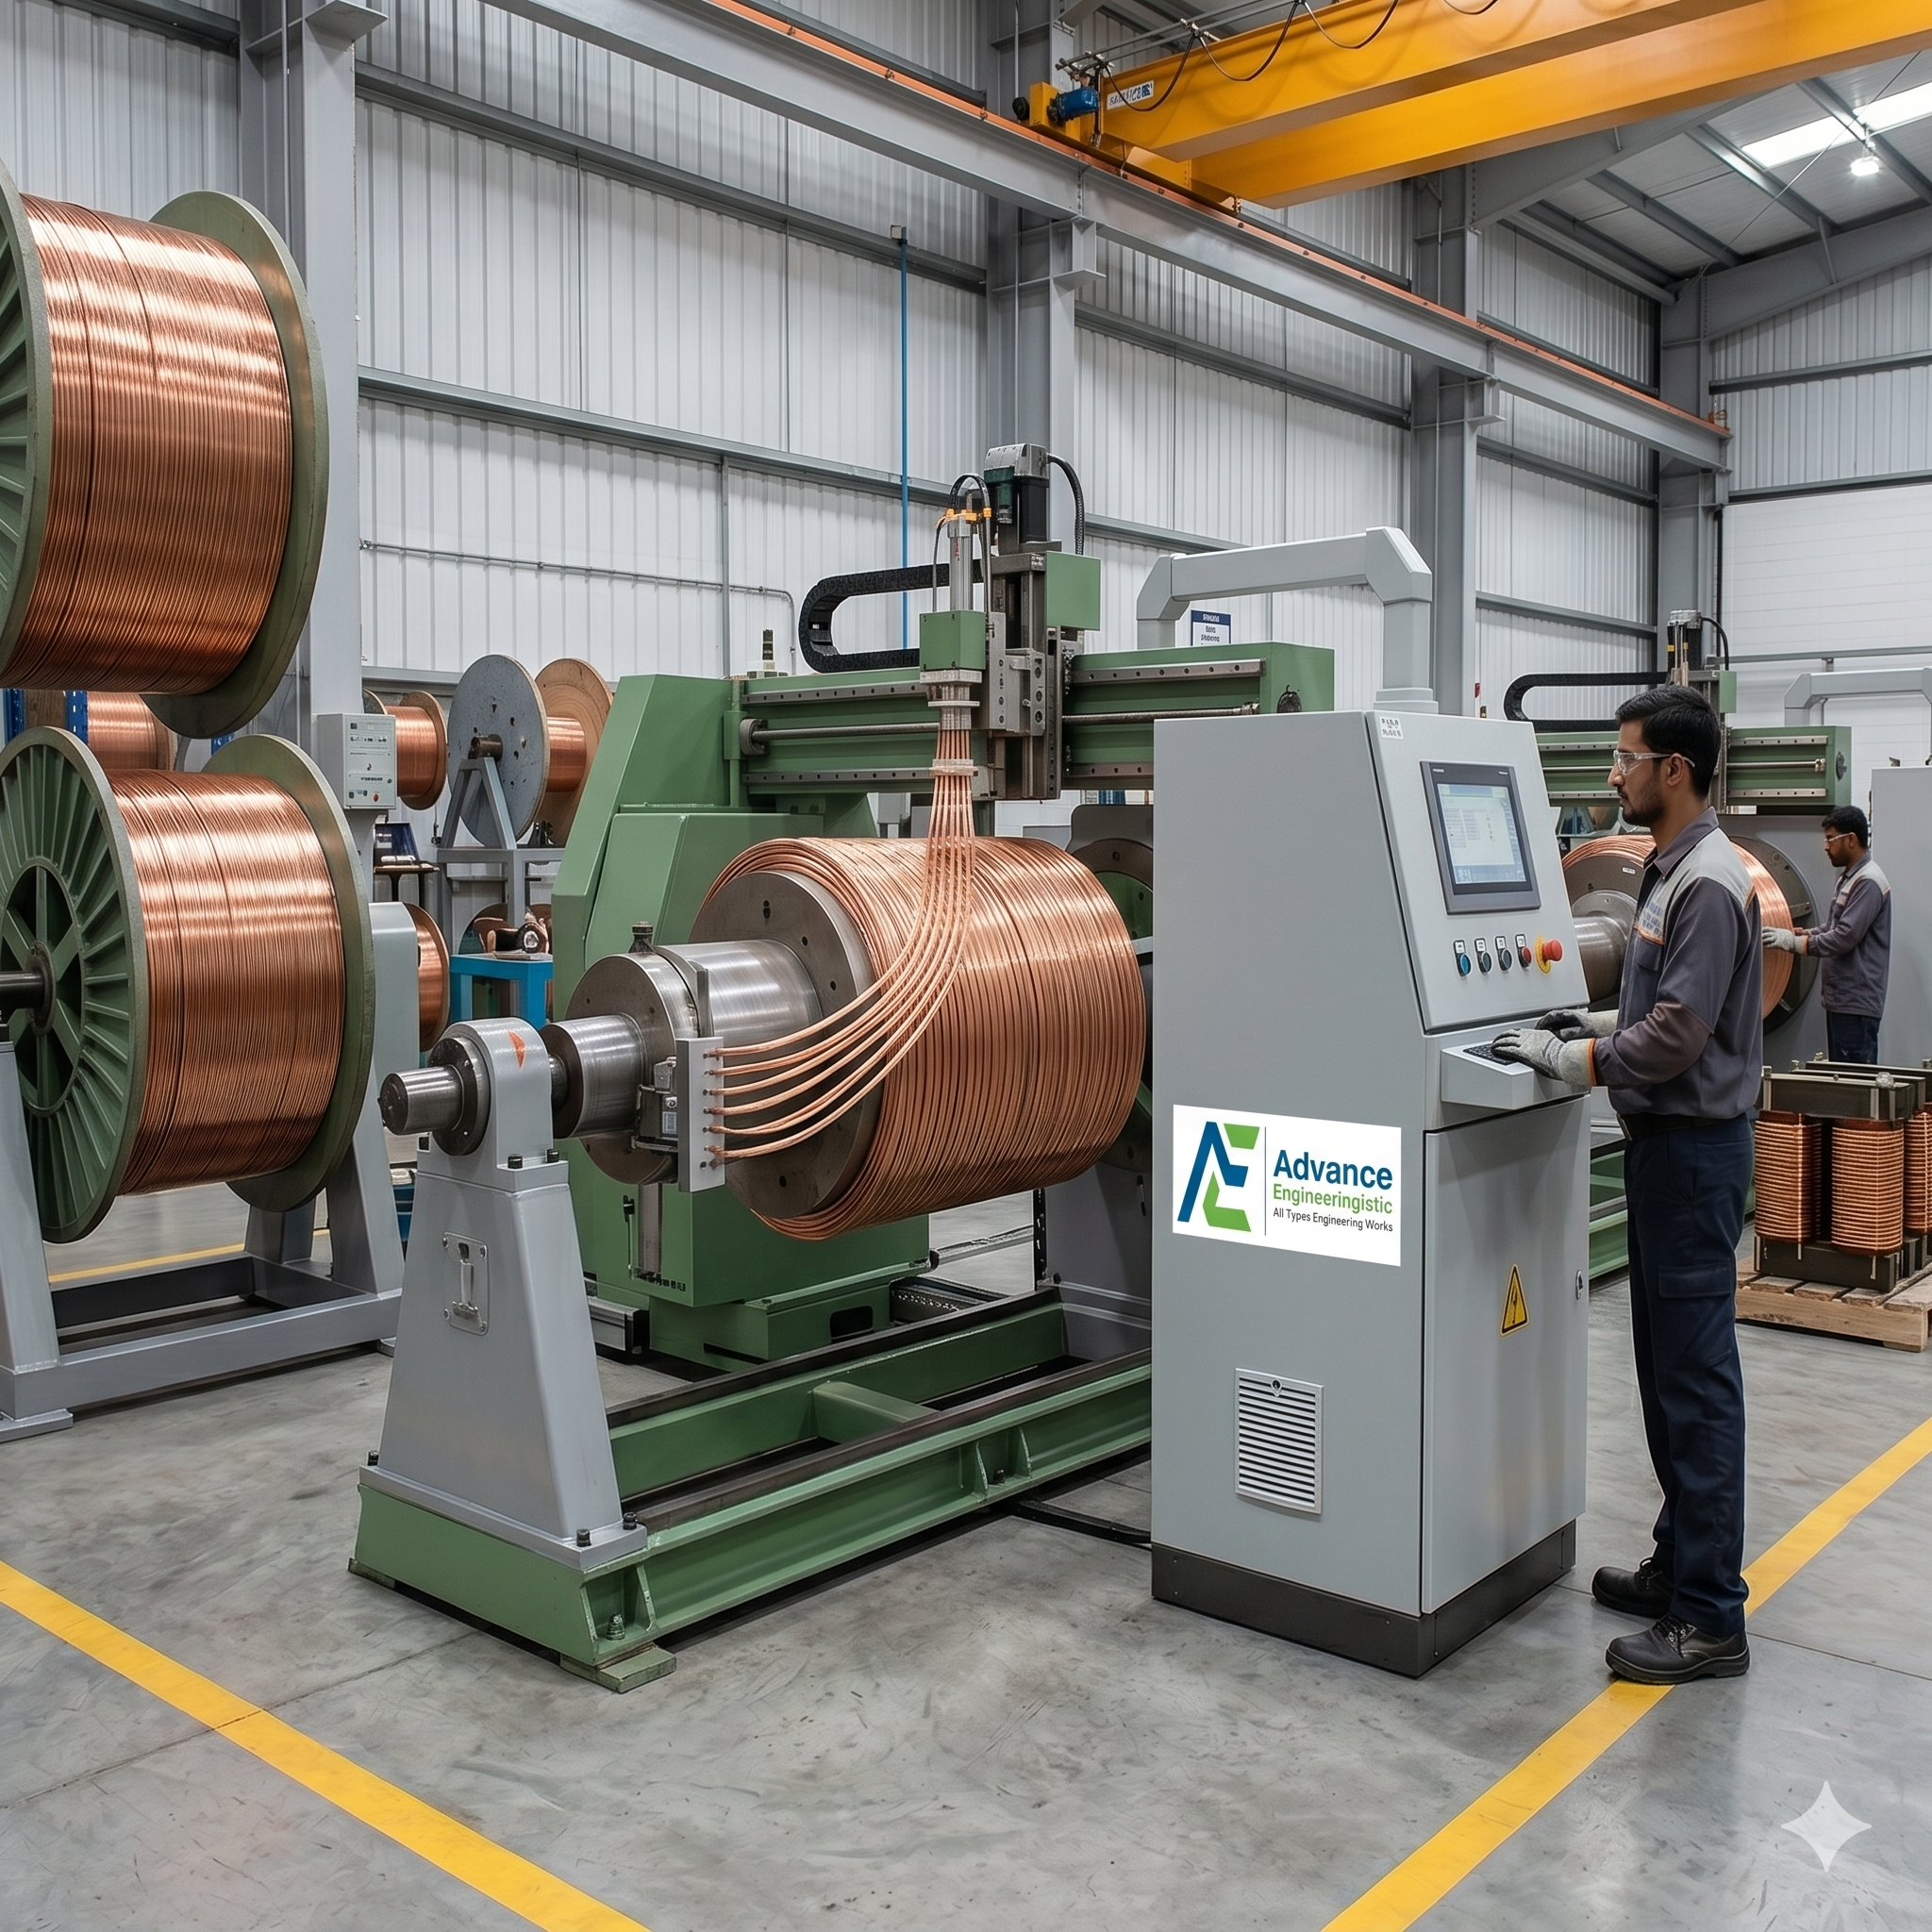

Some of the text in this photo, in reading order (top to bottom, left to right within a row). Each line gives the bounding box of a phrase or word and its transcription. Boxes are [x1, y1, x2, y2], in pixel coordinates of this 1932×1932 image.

[1273, 1149, 1393, 1191] Advance
[1273, 1183, 1393, 1215] Engineeringistic
[1273, 1208, 1393, 1232] All Types Engineering Works
